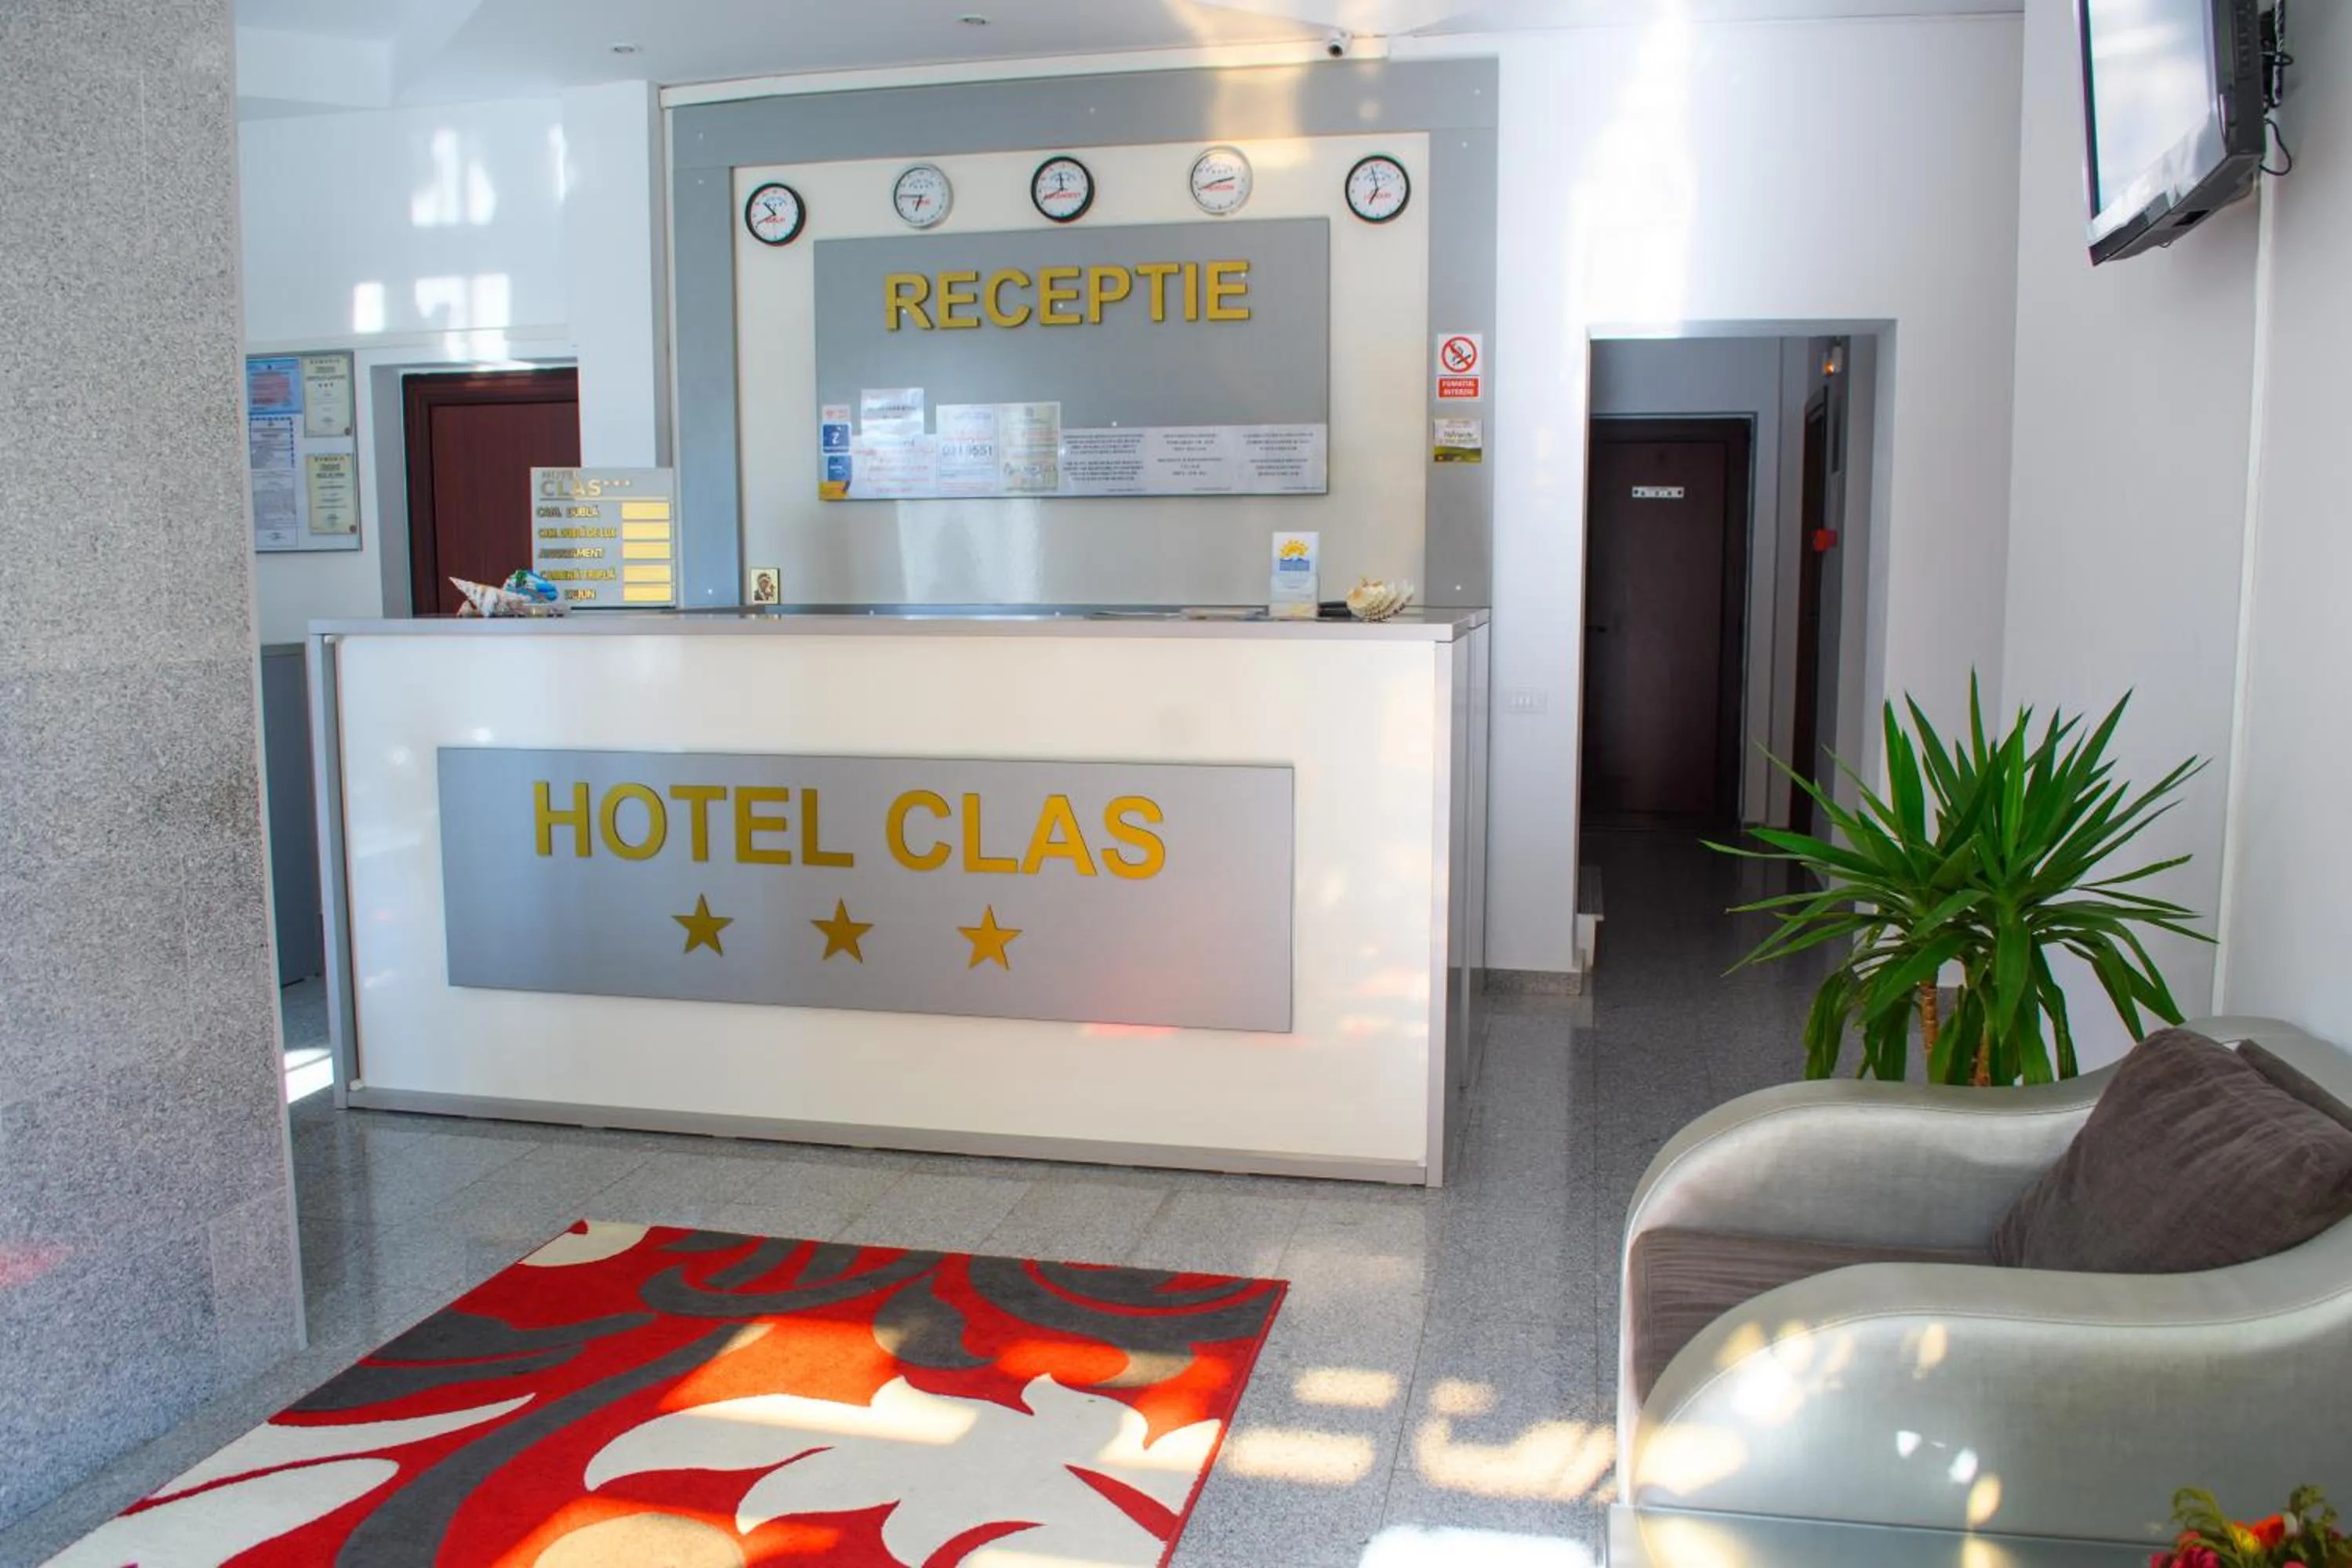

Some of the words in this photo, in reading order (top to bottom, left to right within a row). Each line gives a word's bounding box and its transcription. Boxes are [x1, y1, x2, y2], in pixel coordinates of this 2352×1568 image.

[884, 260, 1250, 330] RECEPTIE
[540, 478, 601, 497] CLAS
[531, 779, 855, 868] HOTEL
[884, 788, 1167, 880] CLAS
